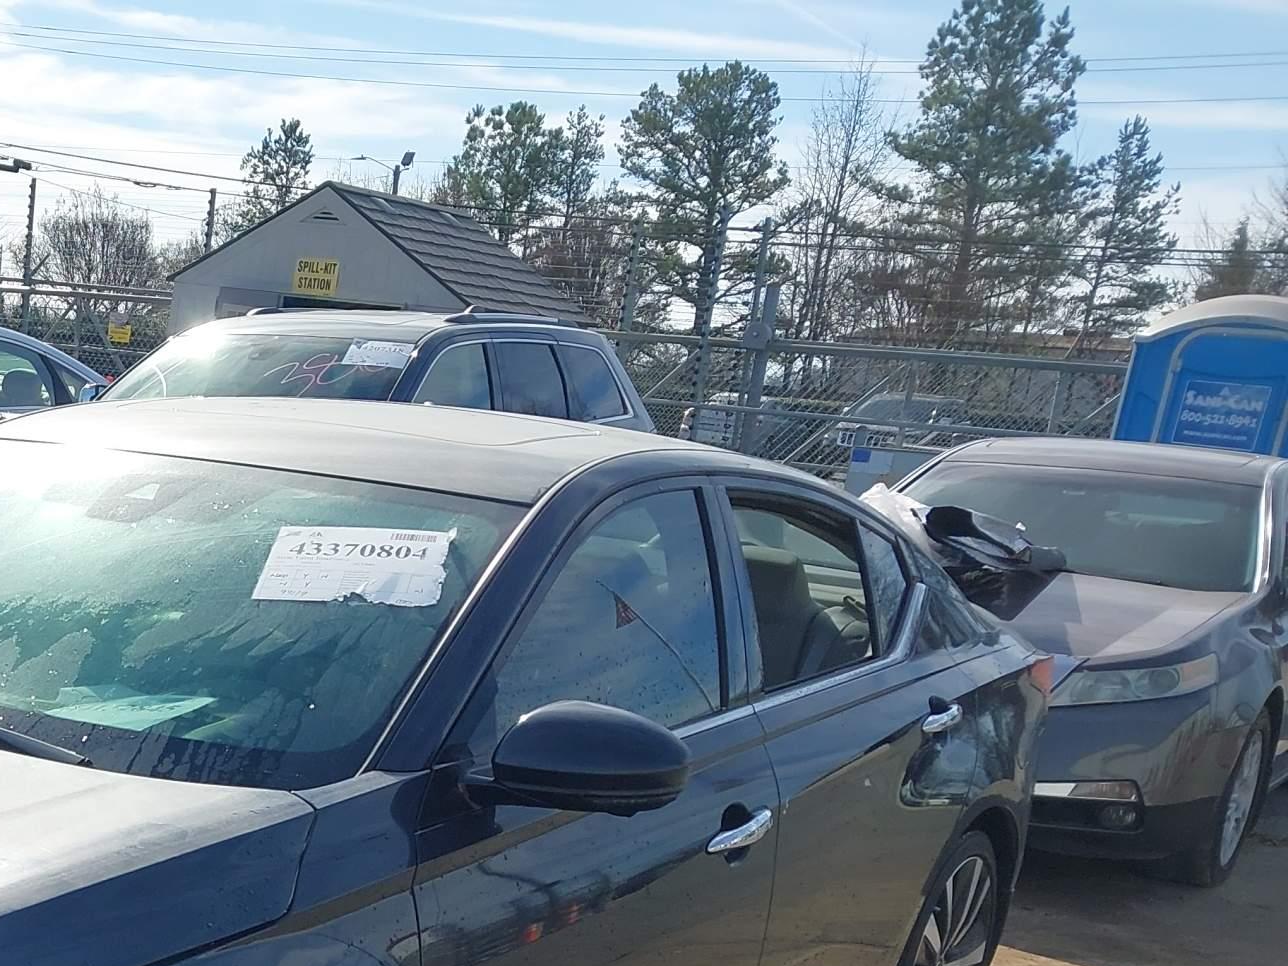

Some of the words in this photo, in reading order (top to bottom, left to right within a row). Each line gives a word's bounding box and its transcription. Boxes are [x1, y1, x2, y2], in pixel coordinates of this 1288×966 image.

[297, 260, 338, 274] SPILL-KIT
[297, 276, 332, 291] STATION
[288, 541, 430, 561] 43370804
